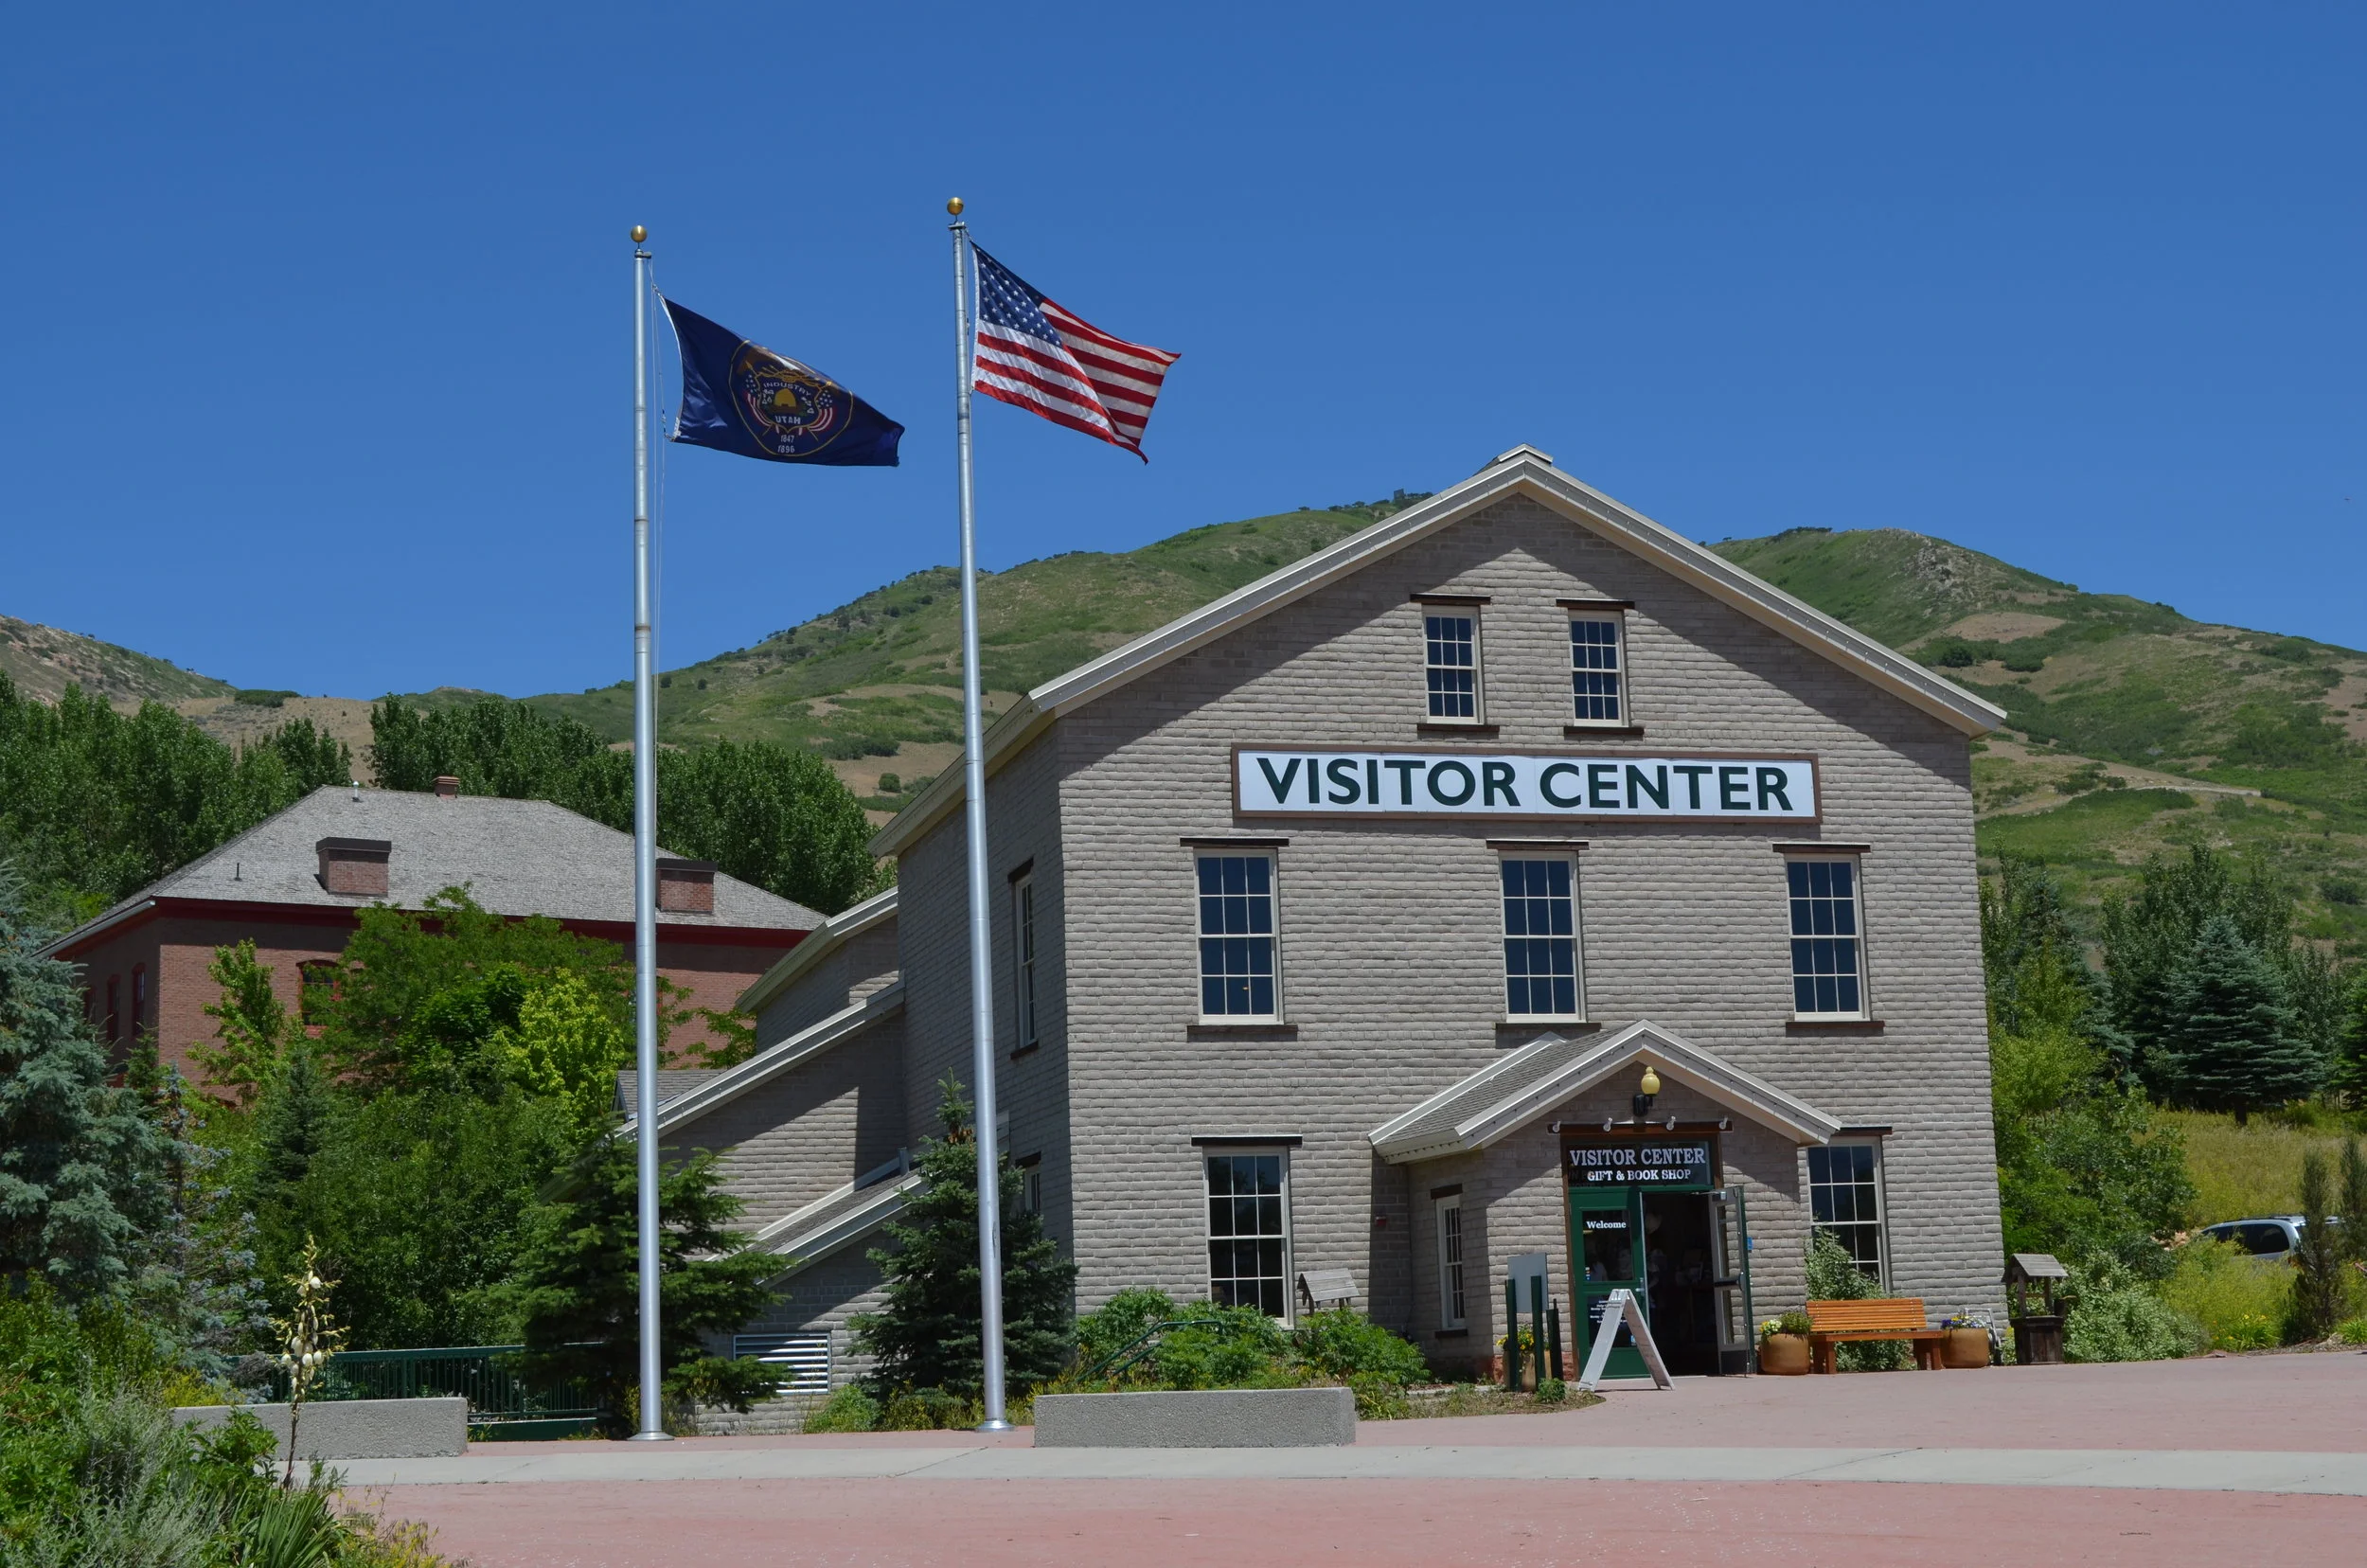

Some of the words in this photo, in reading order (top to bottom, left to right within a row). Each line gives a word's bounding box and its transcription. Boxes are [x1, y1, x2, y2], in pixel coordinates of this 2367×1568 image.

[763, 382, 811, 396] INDUSTRY
[774, 416, 801, 424] UTAH
[780, 435, 794, 443] 1847
[777, 445, 795, 454] 1896
[1256, 757, 1521, 807] VISITOR
[1539, 762, 1793, 811] CENTER
[1570, 1149, 1637, 1166] VISITOR
[1641, 1148, 1706, 1165] CENTER
[1587, 1170, 1613, 1182] GIFT
[1615, 1170, 1626, 1181] &
[1628, 1169, 1659, 1181] BOOK
[1662, 1168, 1691, 1180] SHOP
[1586, 1221, 1627, 1229] Welcome
